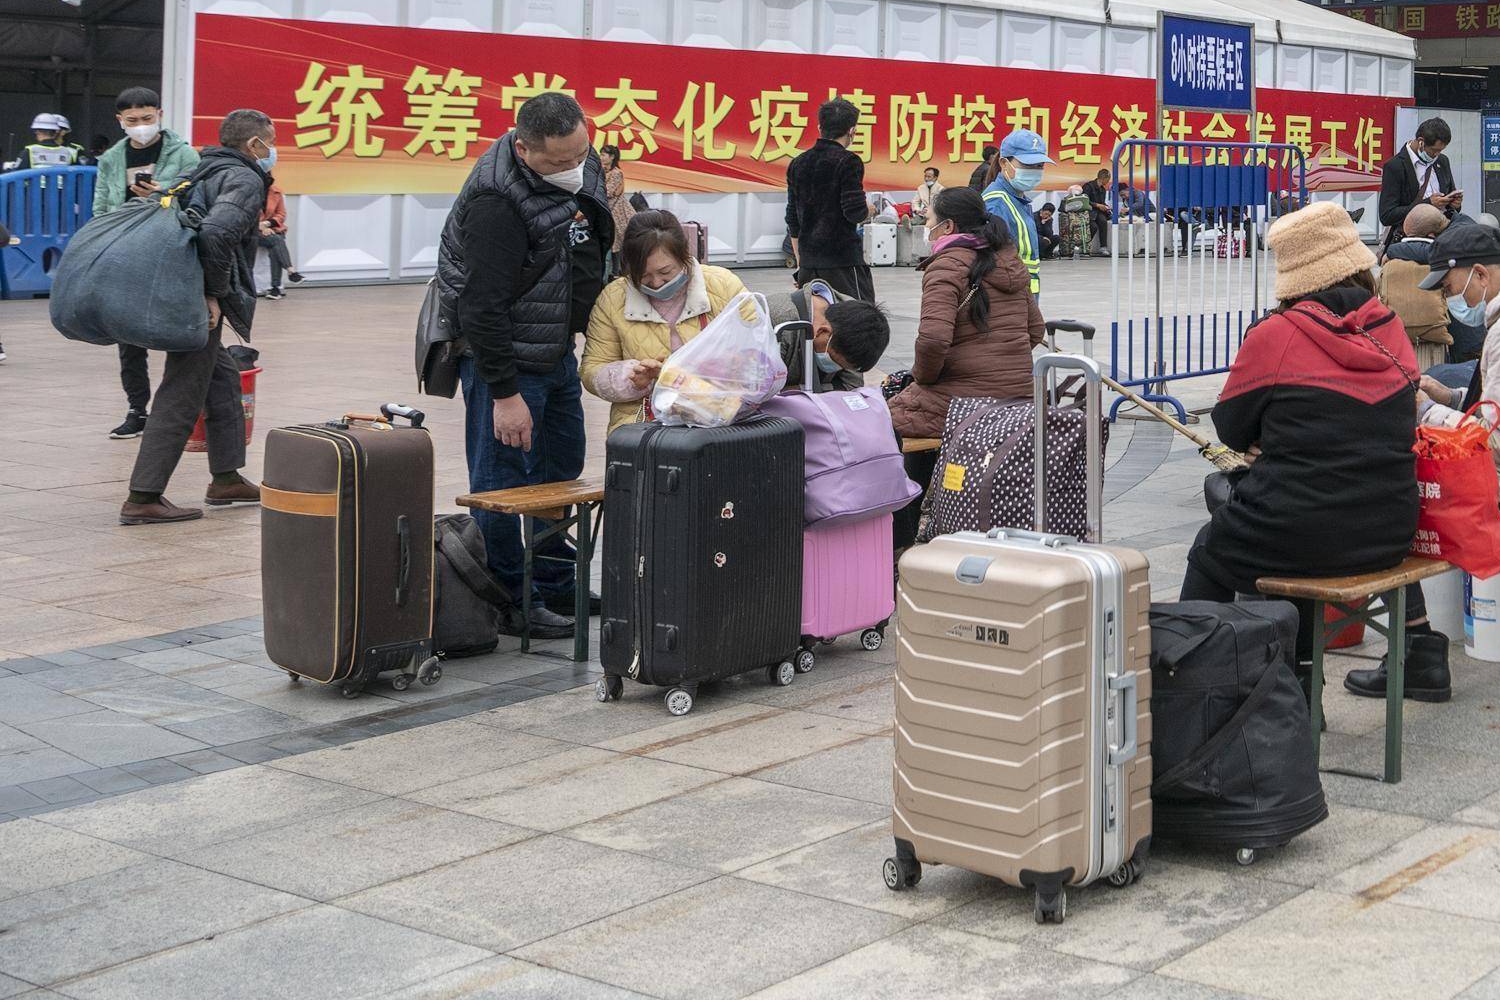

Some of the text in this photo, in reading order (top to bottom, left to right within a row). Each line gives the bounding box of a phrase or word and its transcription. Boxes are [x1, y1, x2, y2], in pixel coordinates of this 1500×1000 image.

[1171, 33, 1244, 91] 8小时持票候车区
